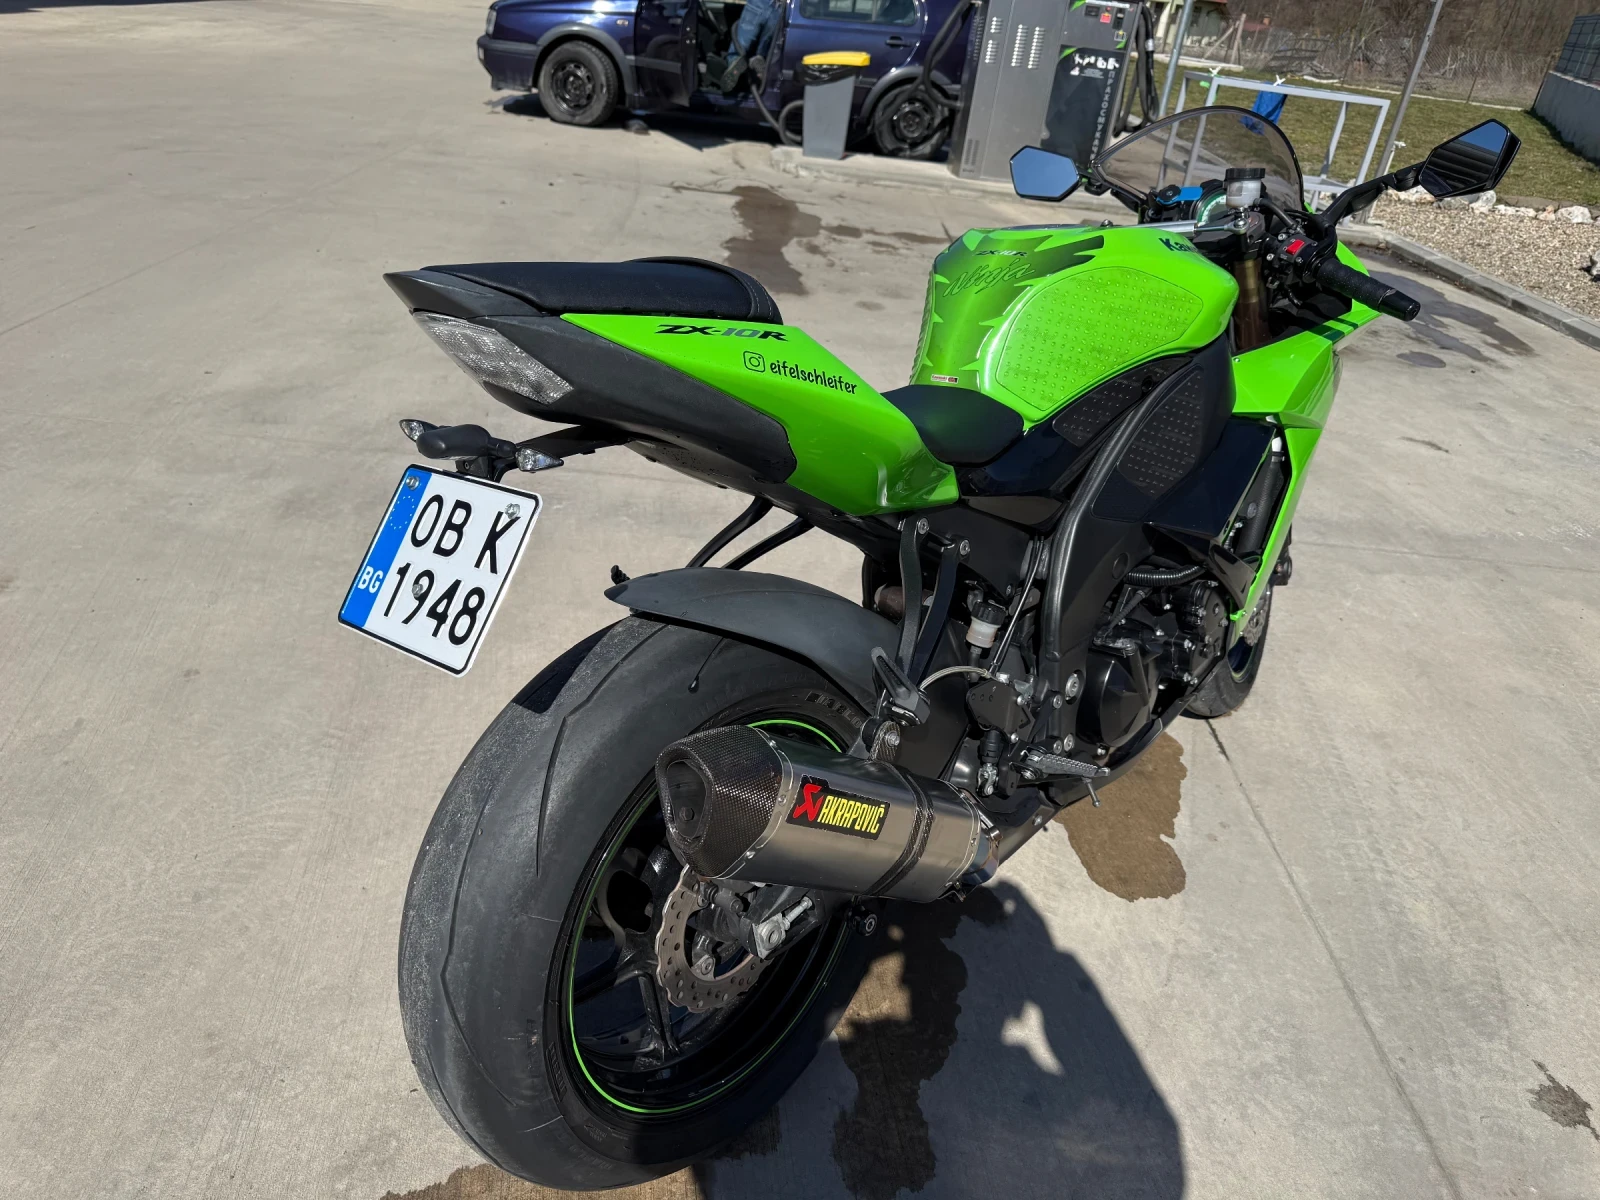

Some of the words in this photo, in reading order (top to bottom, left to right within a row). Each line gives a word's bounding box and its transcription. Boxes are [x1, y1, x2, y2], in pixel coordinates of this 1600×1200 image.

[942, 258, 1036, 297] Ninja
[655, 324, 789, 342] ZX-10R
[769, 359, 858, 394] eifelschleifer
[474, 510, 521, 575] K
[357, 565, 384, 593] BG
[383, 562, 486, 646] 1948
